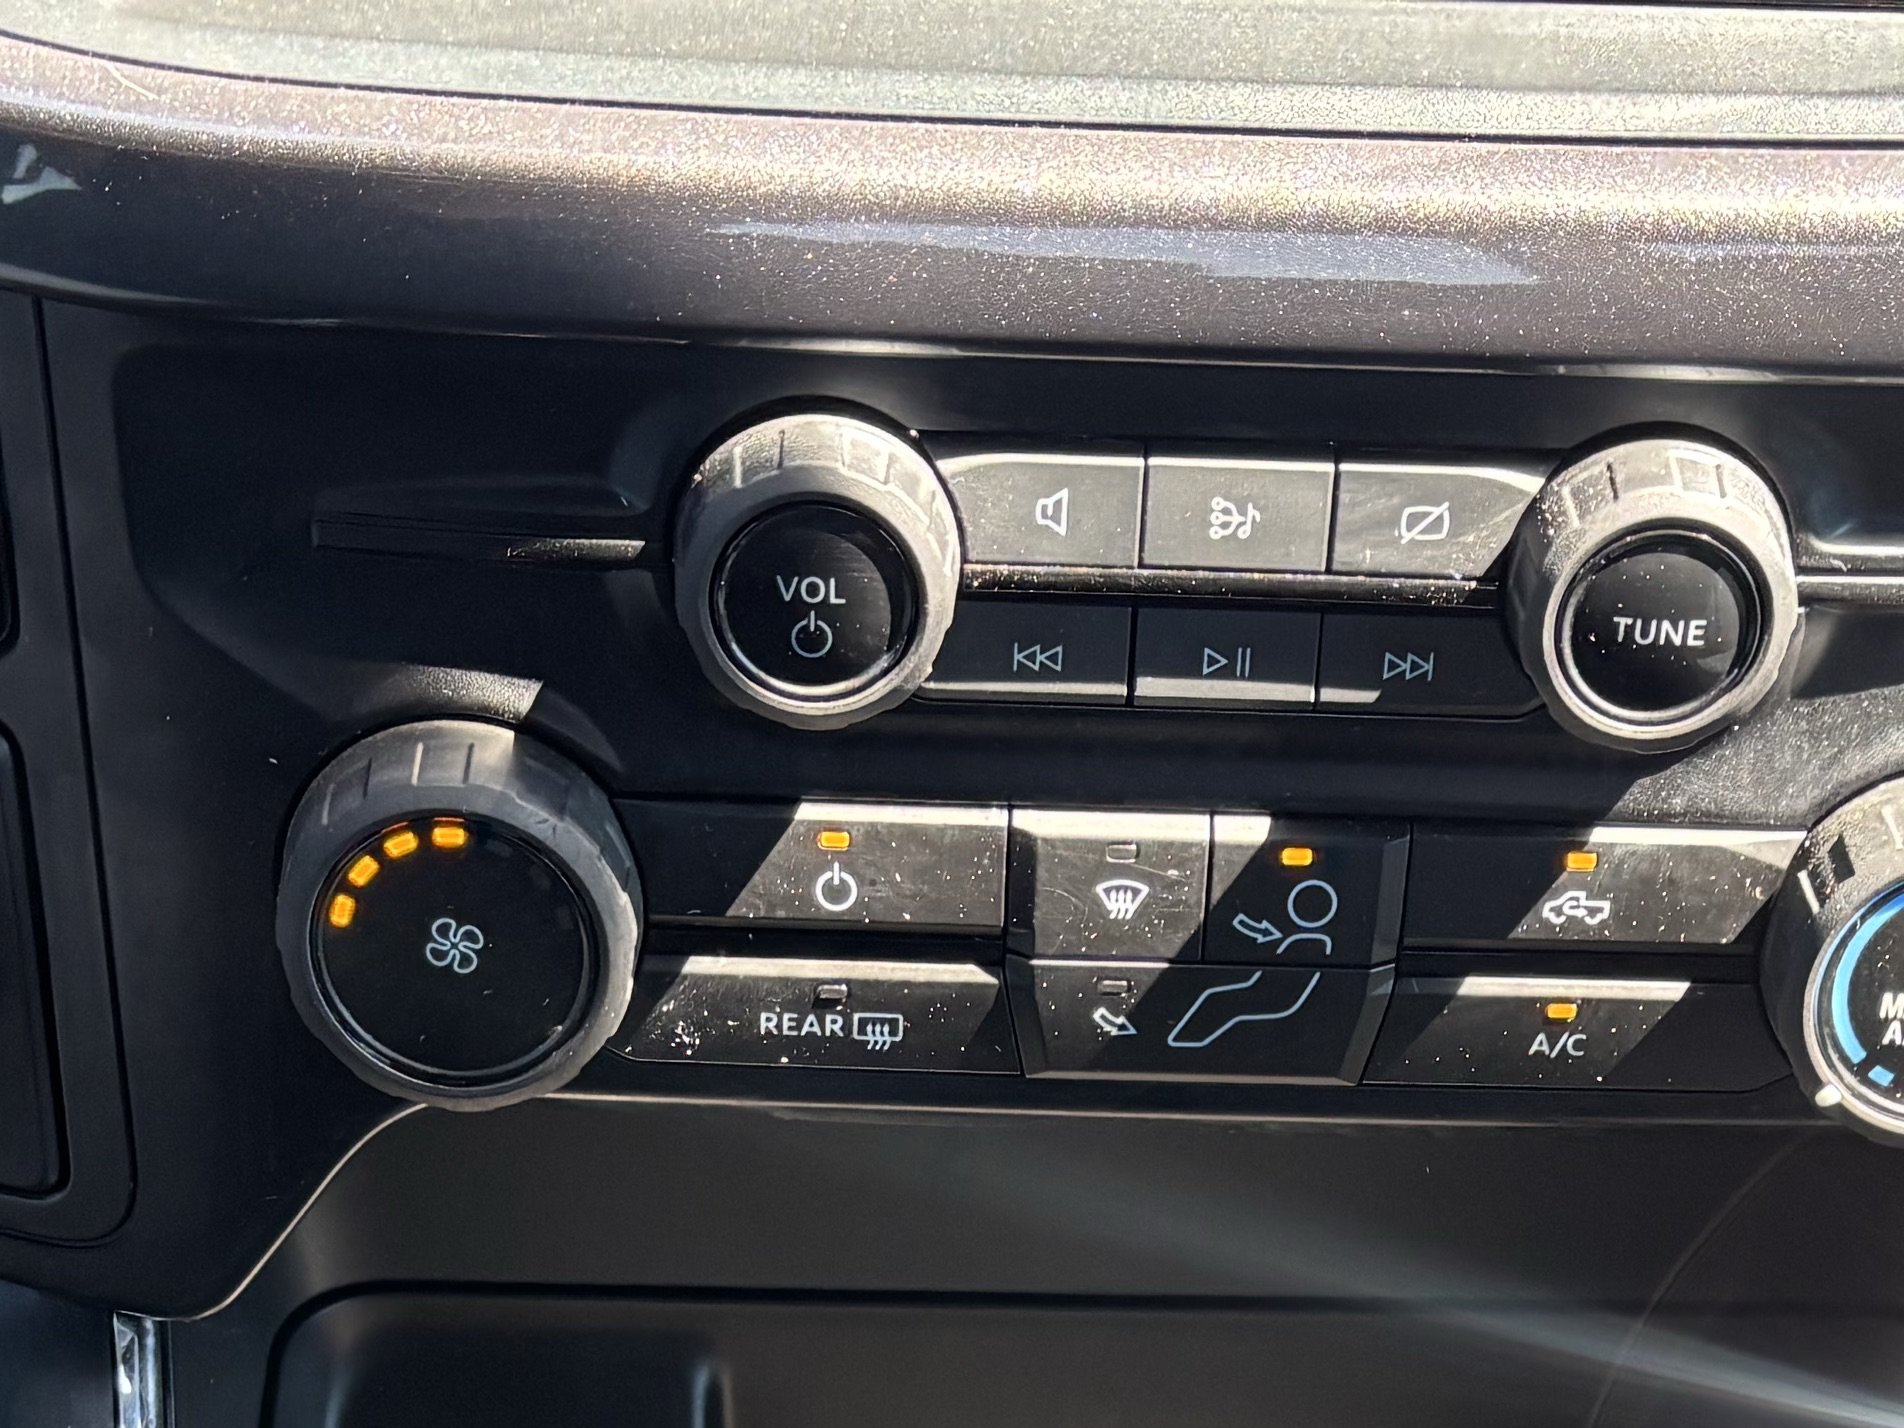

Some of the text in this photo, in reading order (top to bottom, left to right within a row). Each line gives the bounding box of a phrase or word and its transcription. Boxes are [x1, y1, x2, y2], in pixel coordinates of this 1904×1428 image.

[776, 575, 846, 606] VOL
[1612, 614, 1708, 647] TUNE
[758, 1010, 845, 1038] REAR
[1527, 1030, 1587, 1059] A/C
